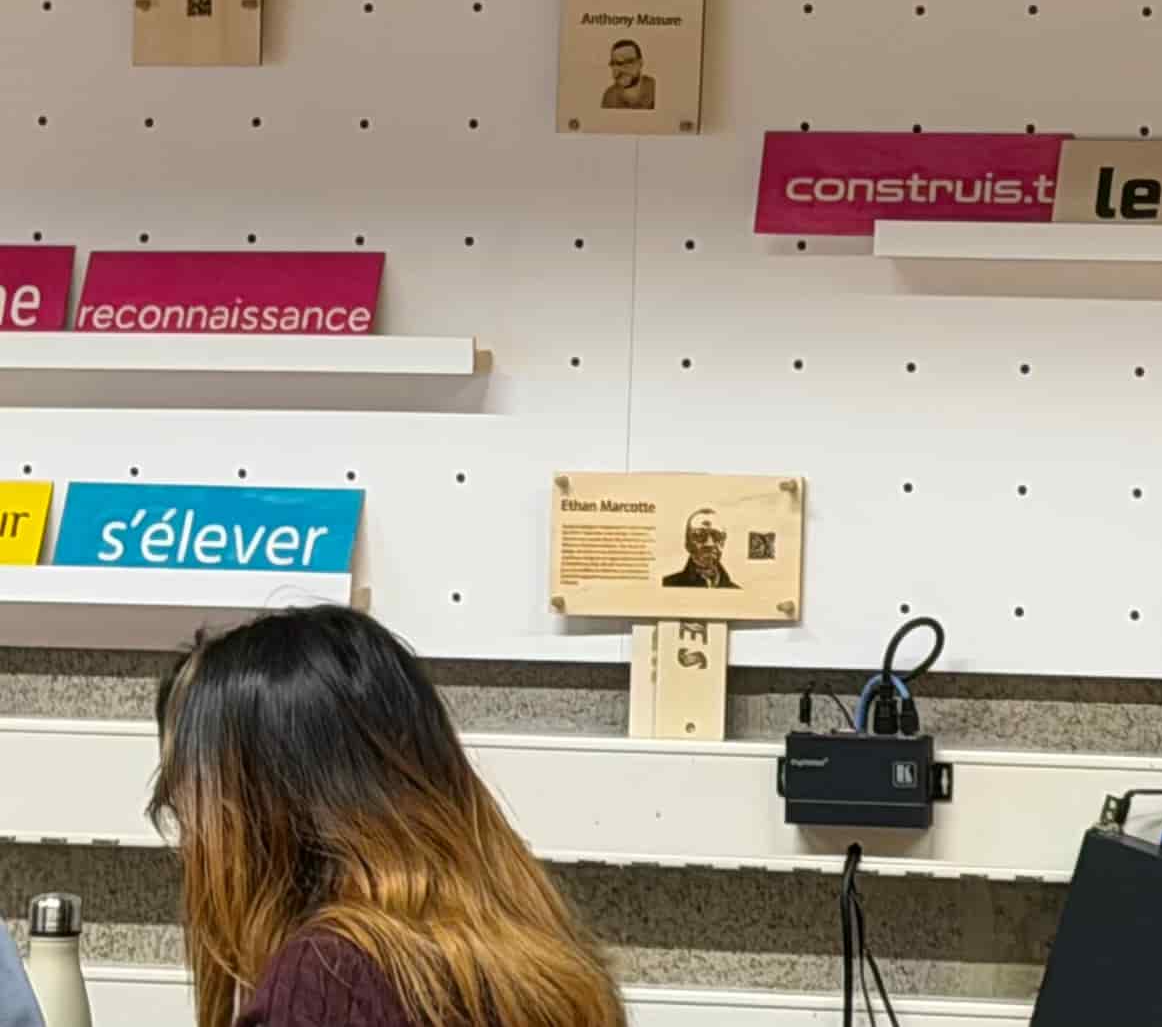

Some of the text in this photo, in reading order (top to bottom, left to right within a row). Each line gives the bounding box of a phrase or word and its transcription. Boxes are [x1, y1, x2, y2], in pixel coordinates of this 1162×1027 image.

[581, 13, 683, 28] Anthony Masure
[1094, 166, 1162, 221] le
[0, 284, 41, 327] e
[77, 296, 372, 333] reconnaissance
[560, 498, 657, 514] Ethan Marcotte
[96, 508, 329, 567] s'élever
